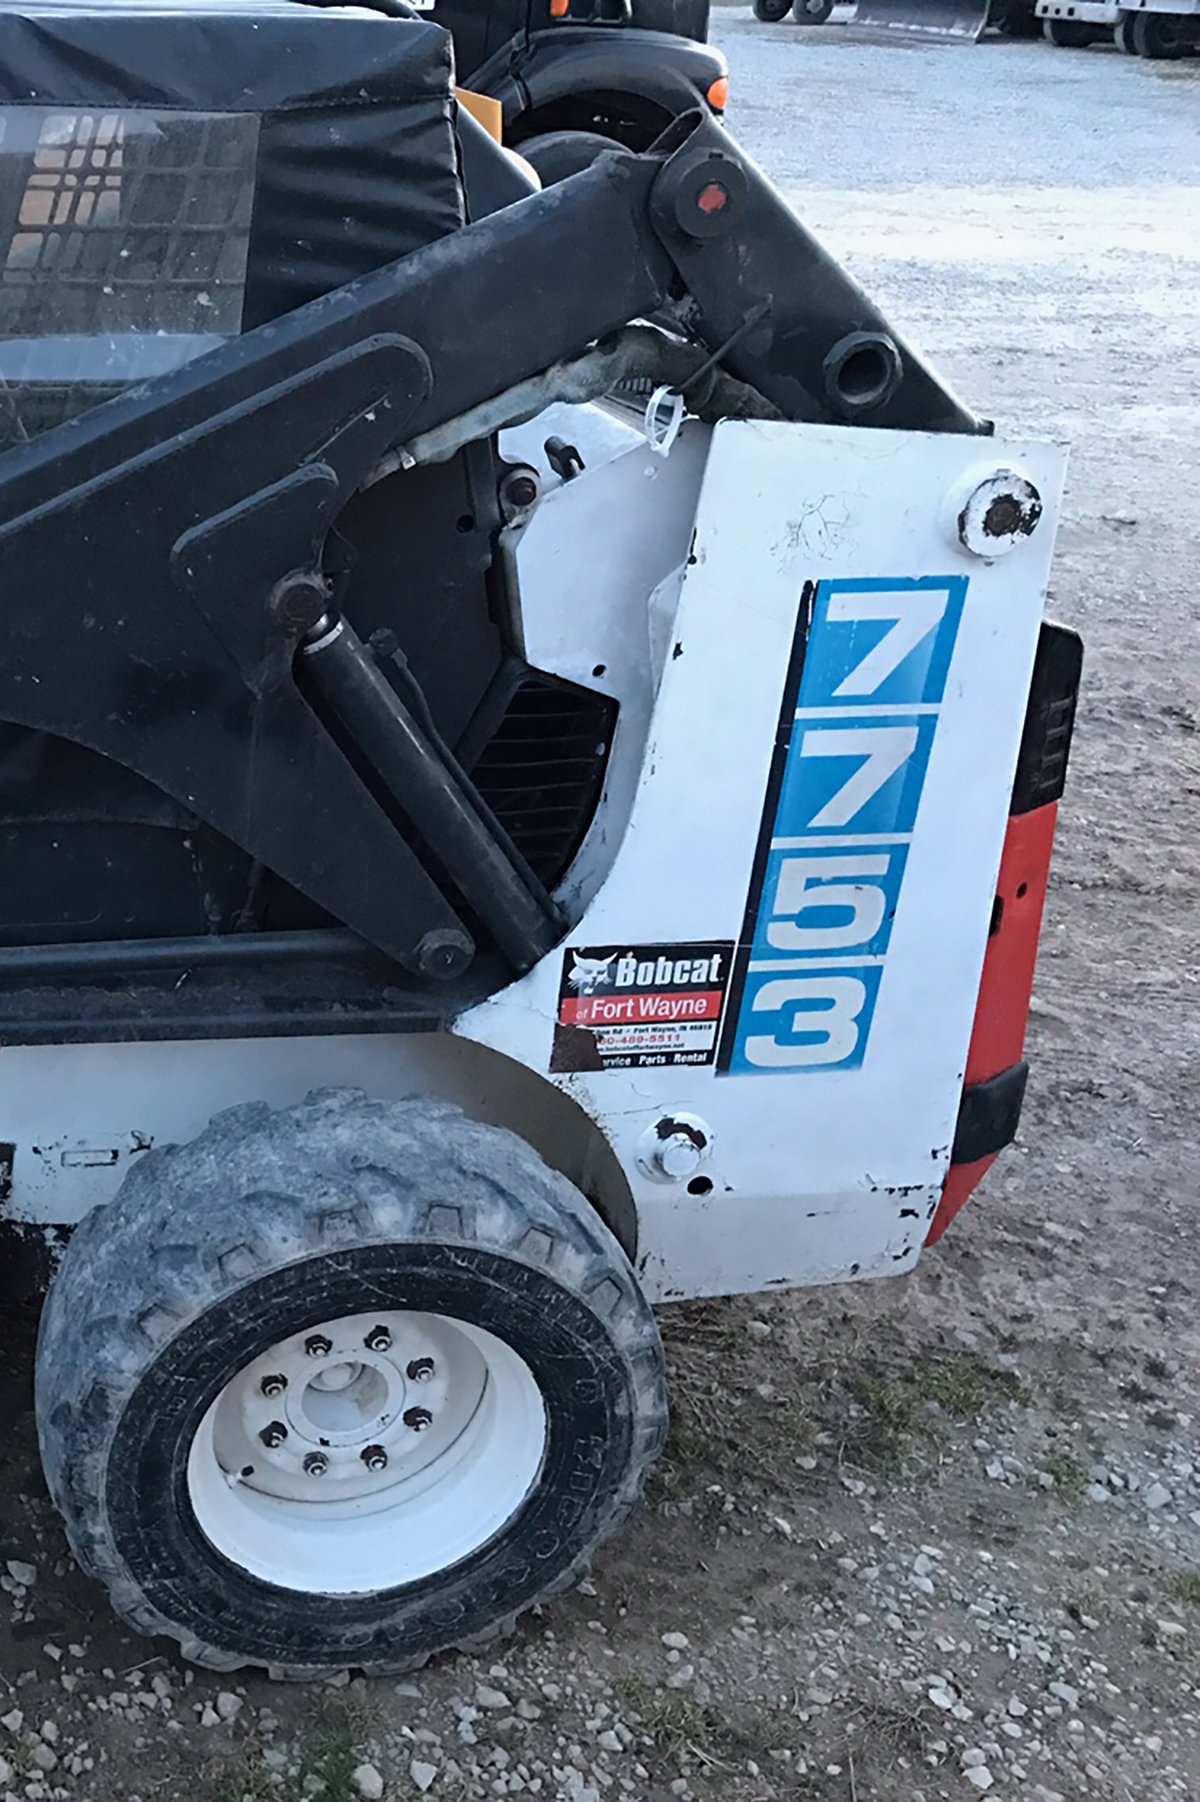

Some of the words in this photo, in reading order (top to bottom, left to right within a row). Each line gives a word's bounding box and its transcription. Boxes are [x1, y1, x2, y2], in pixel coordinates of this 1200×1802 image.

[743, 588, 950, 1068] 7753
[615, 953, 722, 987] Bobcat
[575, 1009, 588, 1020] of
[591, 999, 635, 1020] Fort
[639, 996, 707, 1023] Wayne
[600, 1034, 681, 1045] 60-489-5511
[633, 1026, 649, 1034] Fort
[603, 1056, 631, 1067] rvice
[639, 1054, 666, 1065] Parts
[673, 1052, 707, 1063] Rental
